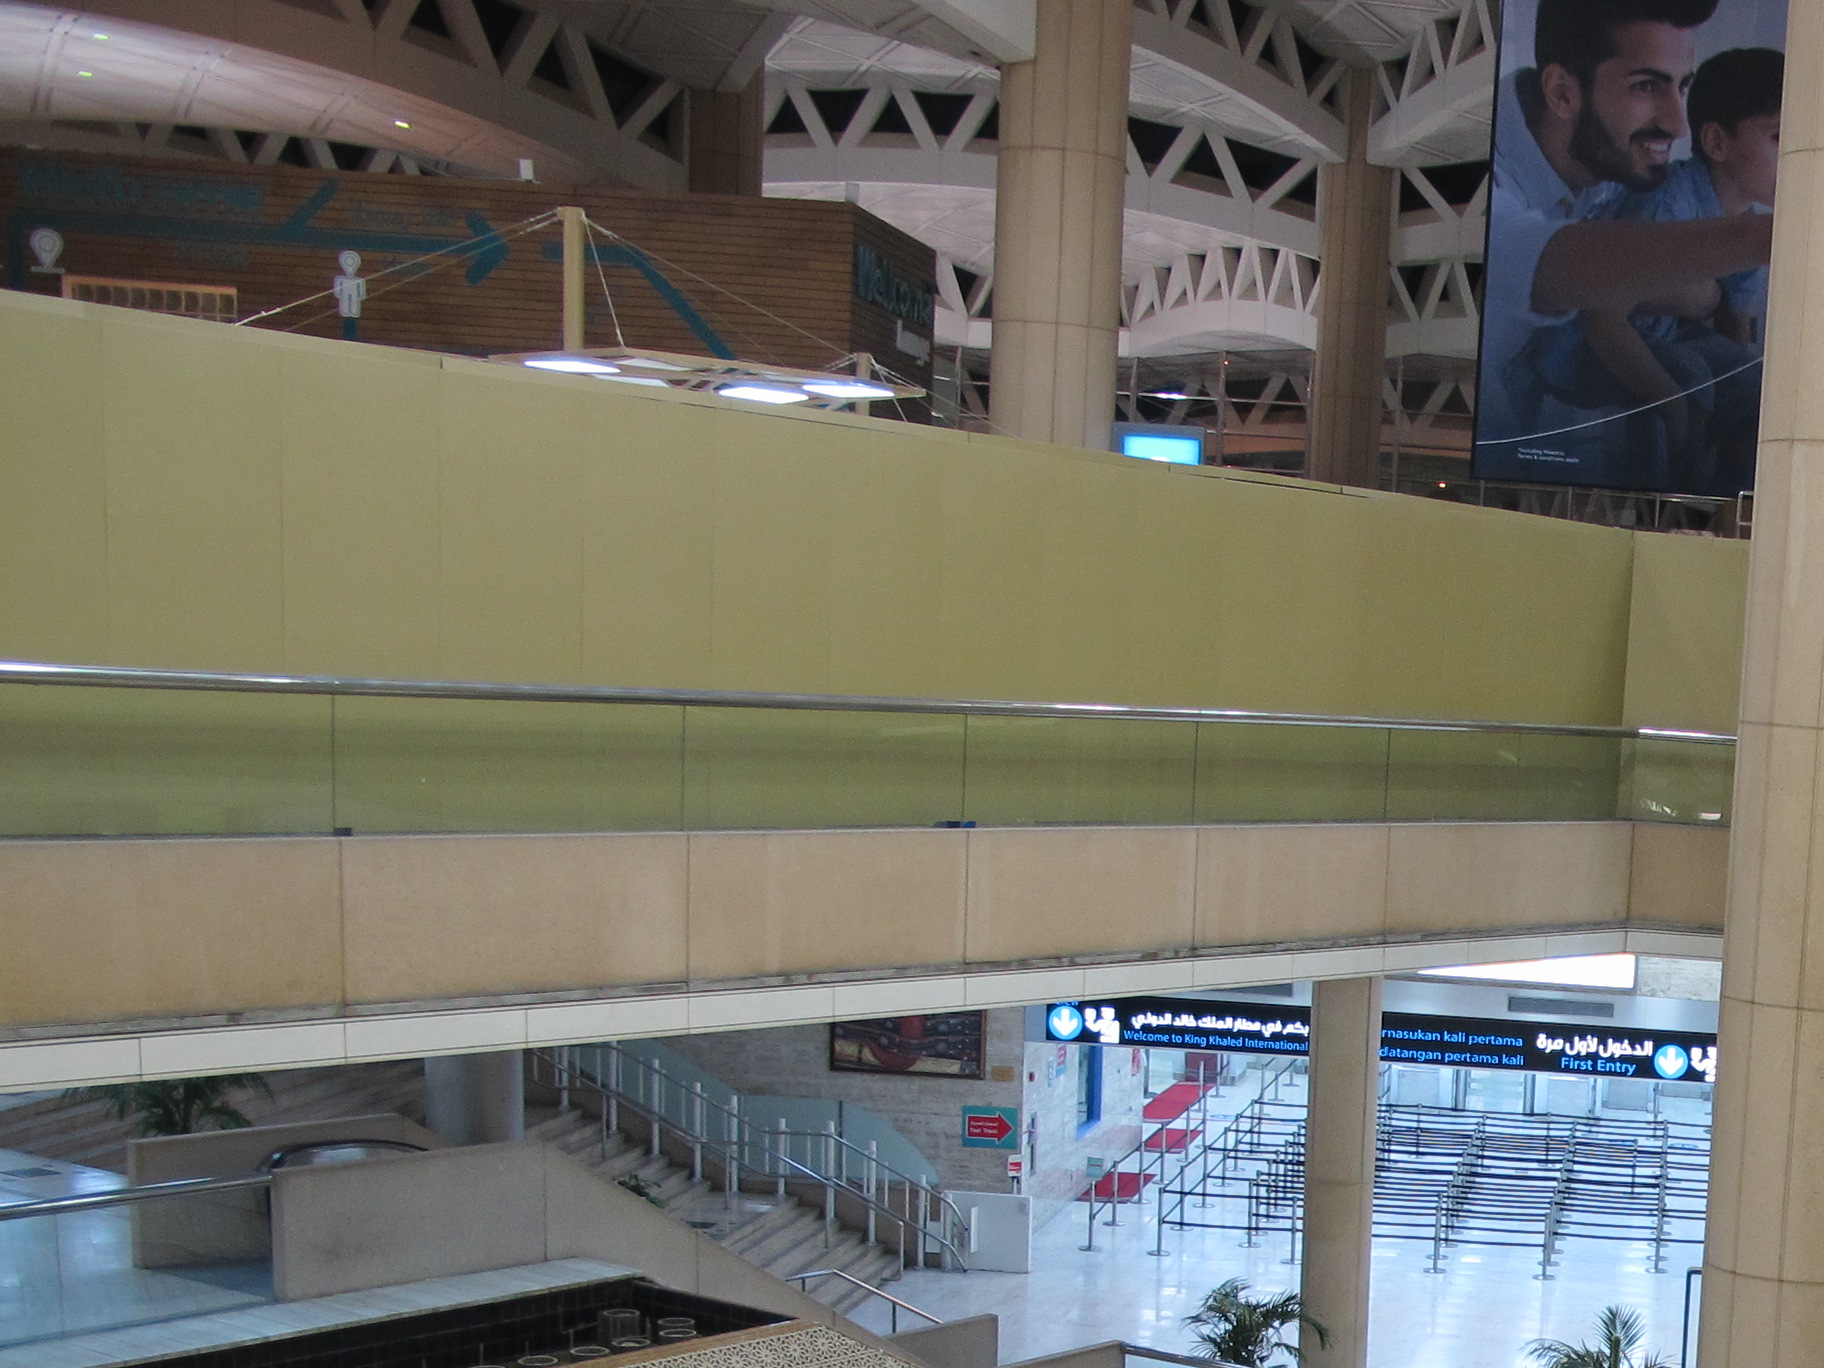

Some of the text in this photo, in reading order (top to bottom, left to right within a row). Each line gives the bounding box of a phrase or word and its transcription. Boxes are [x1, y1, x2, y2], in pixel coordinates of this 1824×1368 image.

[1132, 1012, 1172, 1030] الدولي
[1173, 1014, 1197, 1027] خالد
[1198, 1016, 1232, 1030] الملك
[1233, 1018, 1261, 1032] مطار
[1261, 1020, 1282, 1038] في
[1123, 1030, 1308, 1050] Welcome to King Khaled International
[1443, 1030, 1466, 1043] kali
[1469, 1034, 1524, 1046] pertama
[1536, 1033, 1654, 1058] الدخول لأول مرة
[1444, 1051, 1498, 1064] pertama
[1502, 1054, 1524, 1066] kali
[1561, 1057, 1636, 1076] First Entry
